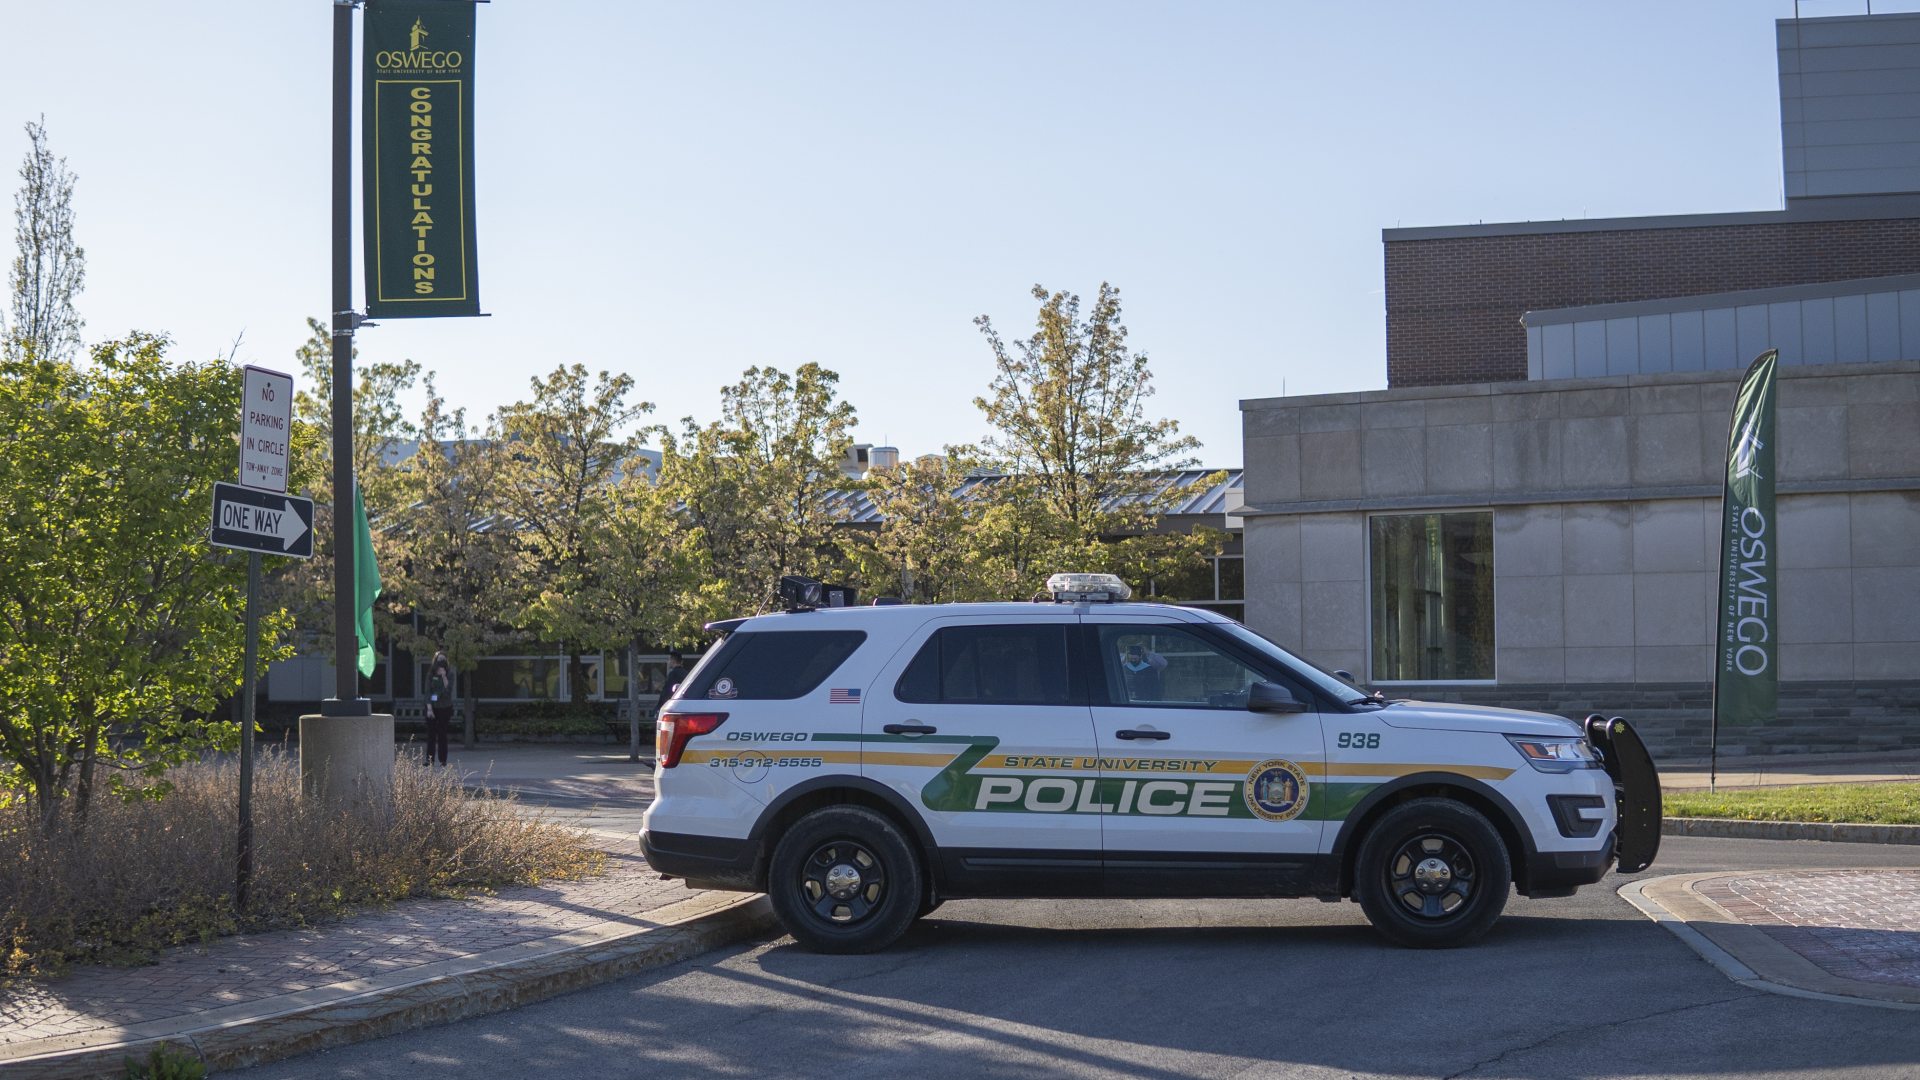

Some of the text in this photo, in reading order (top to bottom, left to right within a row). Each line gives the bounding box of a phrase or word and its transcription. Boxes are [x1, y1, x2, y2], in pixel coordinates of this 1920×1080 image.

[376, 51, 462, 69] OSWEGO
[410, 87, 435, 294] CONGRATULATIONS
[261, 387, 275, 402] NO
[250, 411, 284, 431] PARKING
[246, 436, 284, 456] IN CIRCLE
[245, 461, 283, 477] TOW-AWAY ZONE
[223, 503, 283, 535] ONE WAY
[1725, 504, 1739, 672] STATE UNIVERSITY OF NEW YORK
[1735, 506, 1768, 676] OSWEGO
[726, 731, 808, 742] OSWEGO
[1337, 732, 1381, 749] 938
[709, 757, 822, 768] 315-312-5555
[1003, 756, 1218, 772] STATE UNIVERSITY
[1248, 767, 1262, 785] NEW
[1287, 765, 1305, 786] STATE
[974, 777, 1235, 816] POLICE
[1248, 793, 1306, 820] UNIVERSITY POLICE
